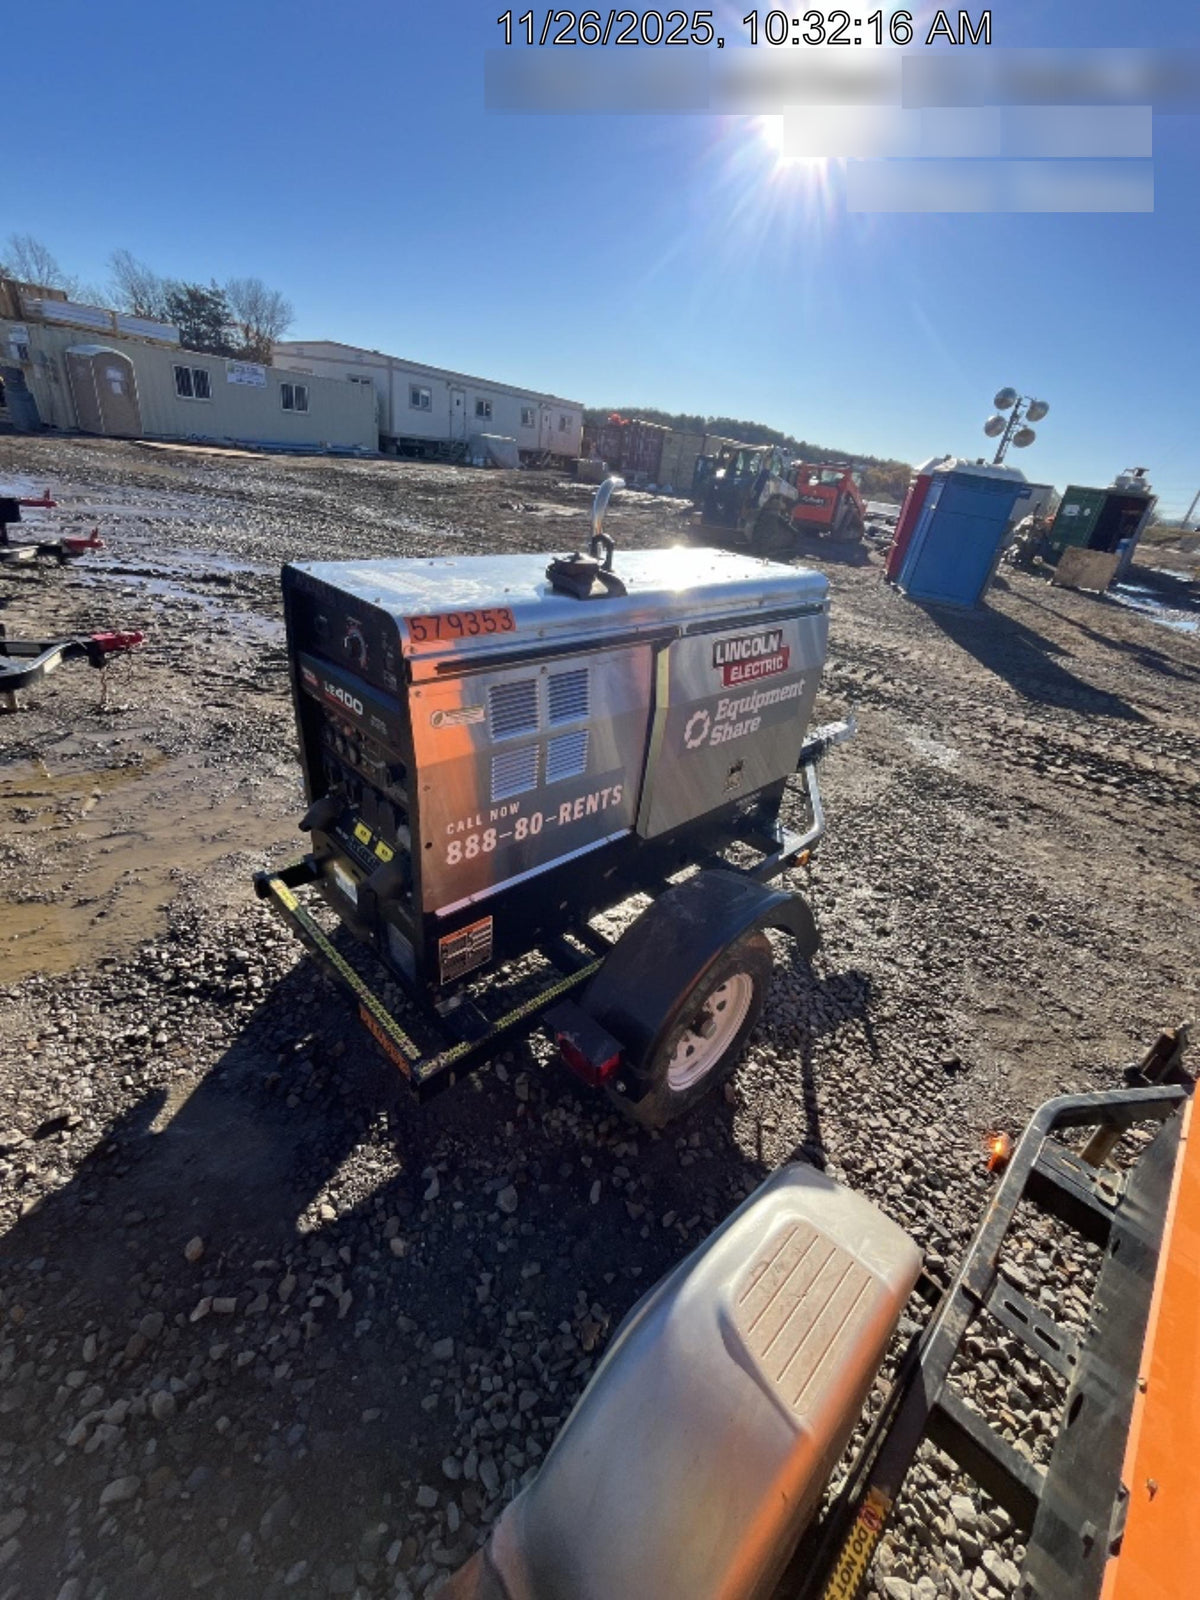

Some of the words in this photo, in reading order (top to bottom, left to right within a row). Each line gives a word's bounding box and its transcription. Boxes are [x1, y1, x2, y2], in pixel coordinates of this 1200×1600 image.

[410, 607, 513, 641] 579353
[716, 633, 780, 664] LINCOLN
[730, 656, 784, 681] ELECTRIC
[715, 678, 806, 721] Equipment
[709, 716, 761, 746] Share
[446, 784, 623, 865] 888-80-RENTS
[447, 814, 482, 835] CALL
[489, 801, 520, 822] NOW
